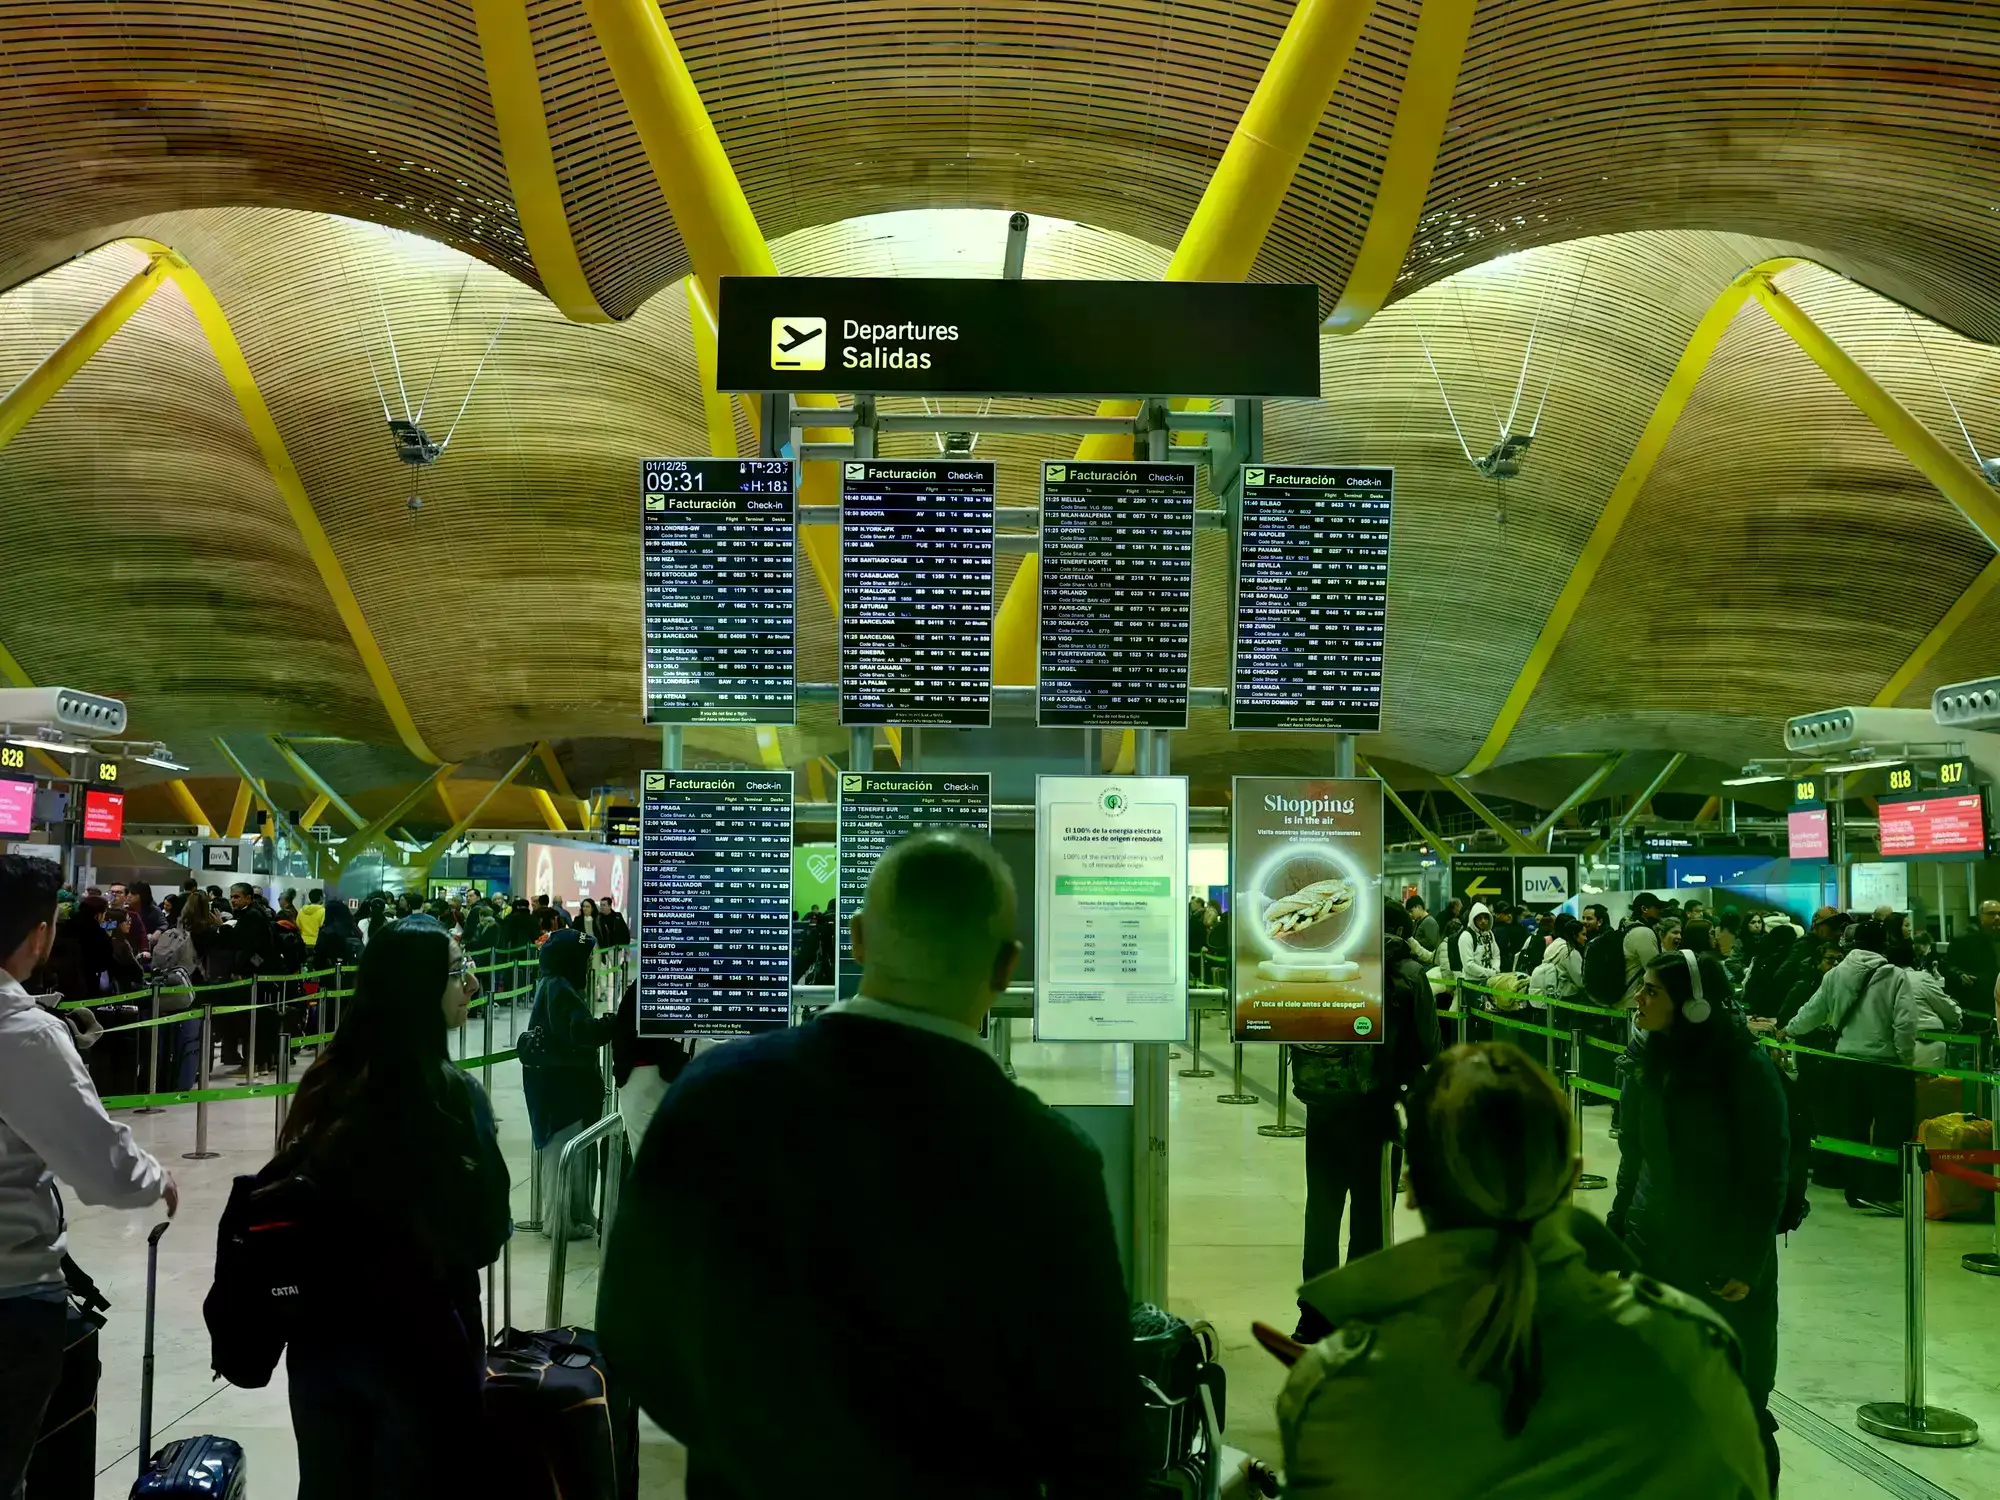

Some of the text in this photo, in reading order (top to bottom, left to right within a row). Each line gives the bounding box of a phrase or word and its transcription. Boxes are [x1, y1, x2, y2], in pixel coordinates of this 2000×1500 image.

[844, 320, 959, 344] Departures
[843, 346, 931, 369] Salidas
[646, 462, 687, 471] 01/12/25
[869, 468, 983, 480] Facturación Check-in
[647, 472, 703, 491] 09:31
[1070, 470, 1184, 482] Facturación Check-in
[1269, 474, 1382, 486] Facturación Check-in
[669, 499, 782, 509] Facturación Check-in
[1, 748, 24, 768] 828
[100, 764, 117, 780] 829
[1890, 770, 1911, 789] 818
[1941, 762, 1963, 783] 817
[669, 779, 781, 790] Facturación Check-in
[866, 781, 979, 791] Facturación Check-in
[1797, 782, 1815, 800] 819
[1264, 794, 1354, 816] Shopping
[1285, 816, 1334, 824] is in the air
